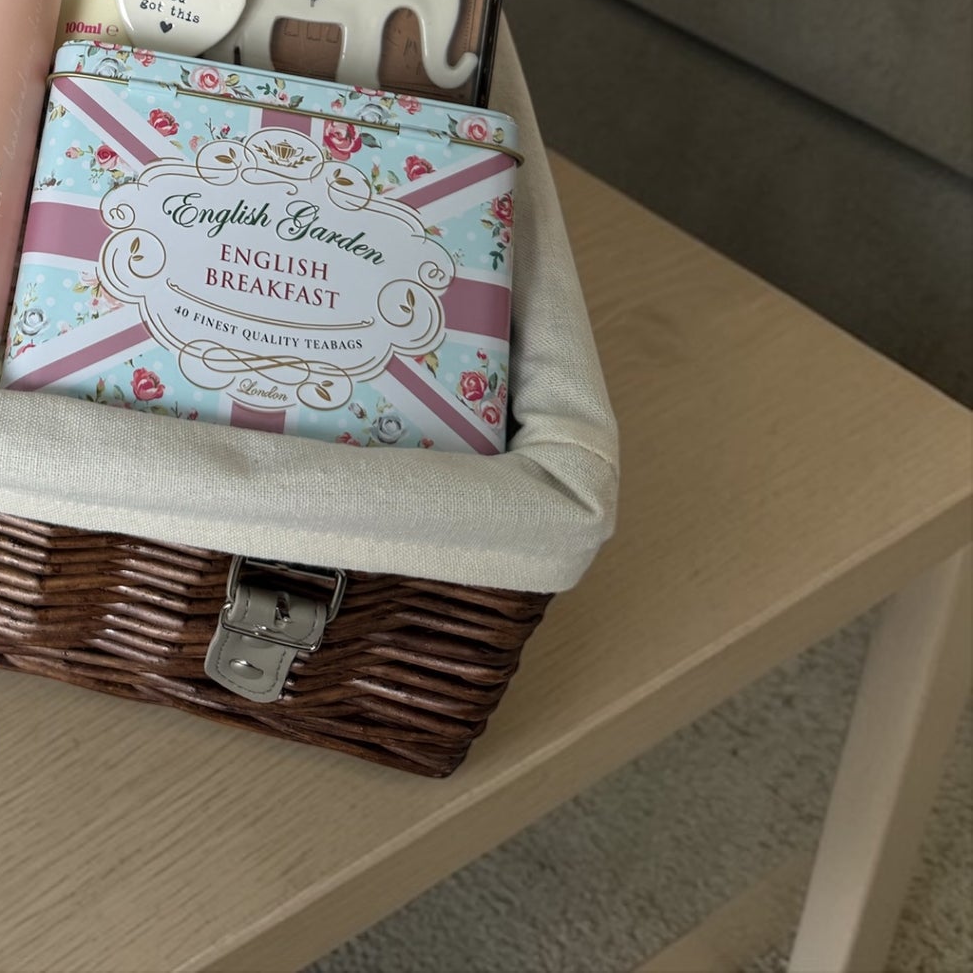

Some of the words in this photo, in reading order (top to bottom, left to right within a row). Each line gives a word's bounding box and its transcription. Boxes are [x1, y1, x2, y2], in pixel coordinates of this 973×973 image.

[65, 21, 102, 35] 100ml
[170, 3, 200, 24] this
[162, 193, 271, 238] English
[276, 200, 385, 266] Garden
[219, 243, 328, 282] ENGLISH
[205, 269, 340, 310] BREAKFAST
[175, 306, 190, 319] 40
[193, 312, 238, 334] FINEST
[242, 328, 300, 348] QUALITY
[304, 338, 363, 350] TEABAGS
[236, 378, 289, 402] London
